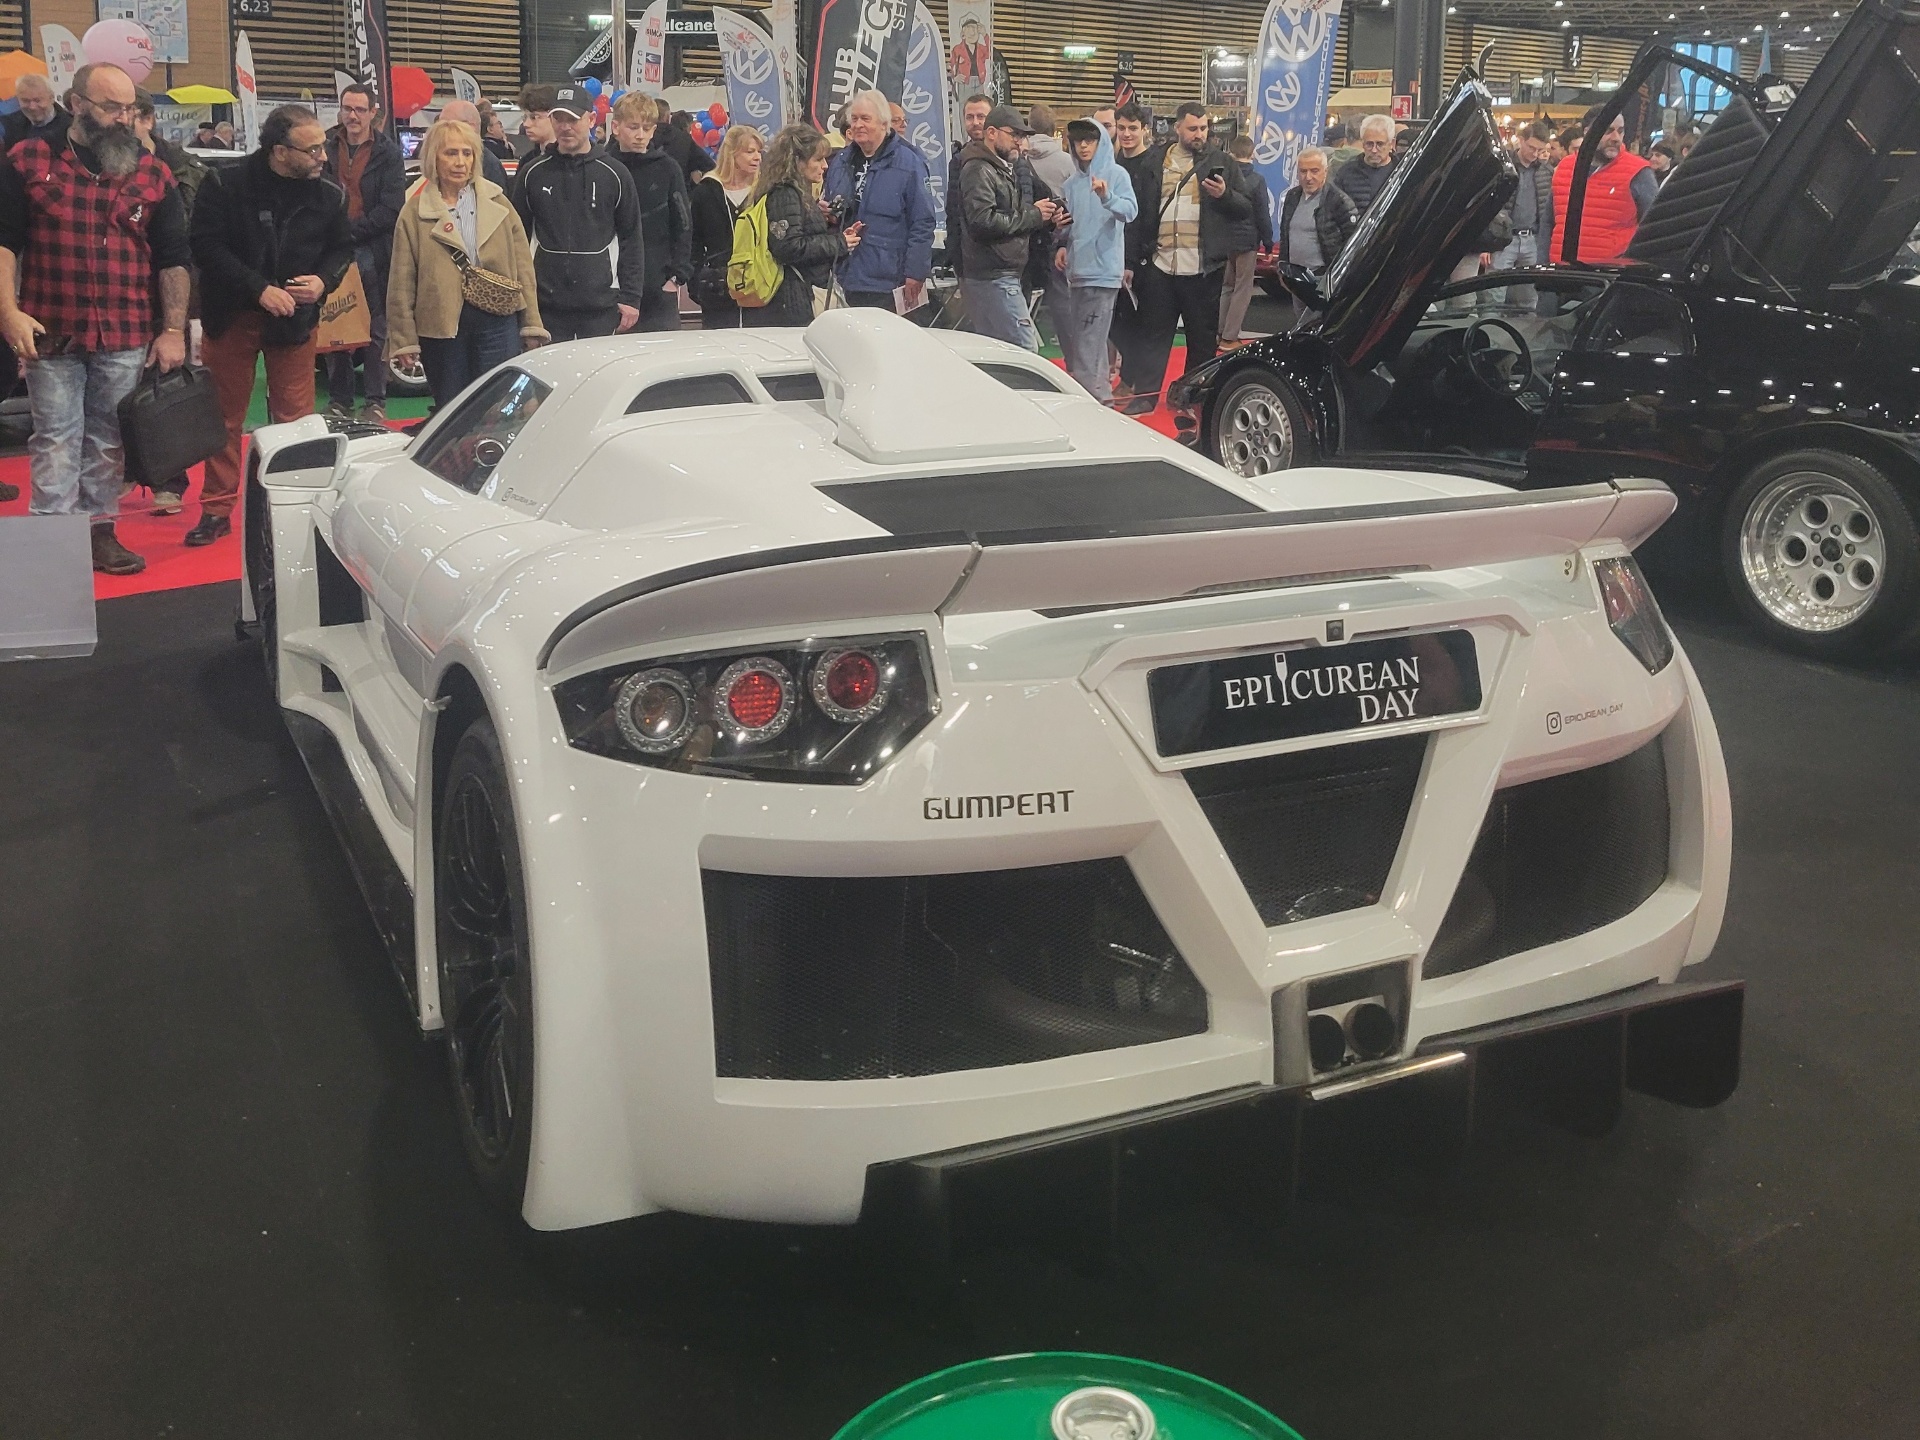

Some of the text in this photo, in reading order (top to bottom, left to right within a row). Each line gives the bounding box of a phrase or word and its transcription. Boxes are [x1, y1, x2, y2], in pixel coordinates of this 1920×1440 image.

[240, 0, 270, 13] 6.23
[583, 31, 612, 63] Vulcanet
[1118, 61, 1134, 72] 6.26
[1358, 689, 1419, 724] DAY
[1564, 703, 1624, 725] EPICUREAN_DAY
[923, 790, 1075, 820] GUMPERT
